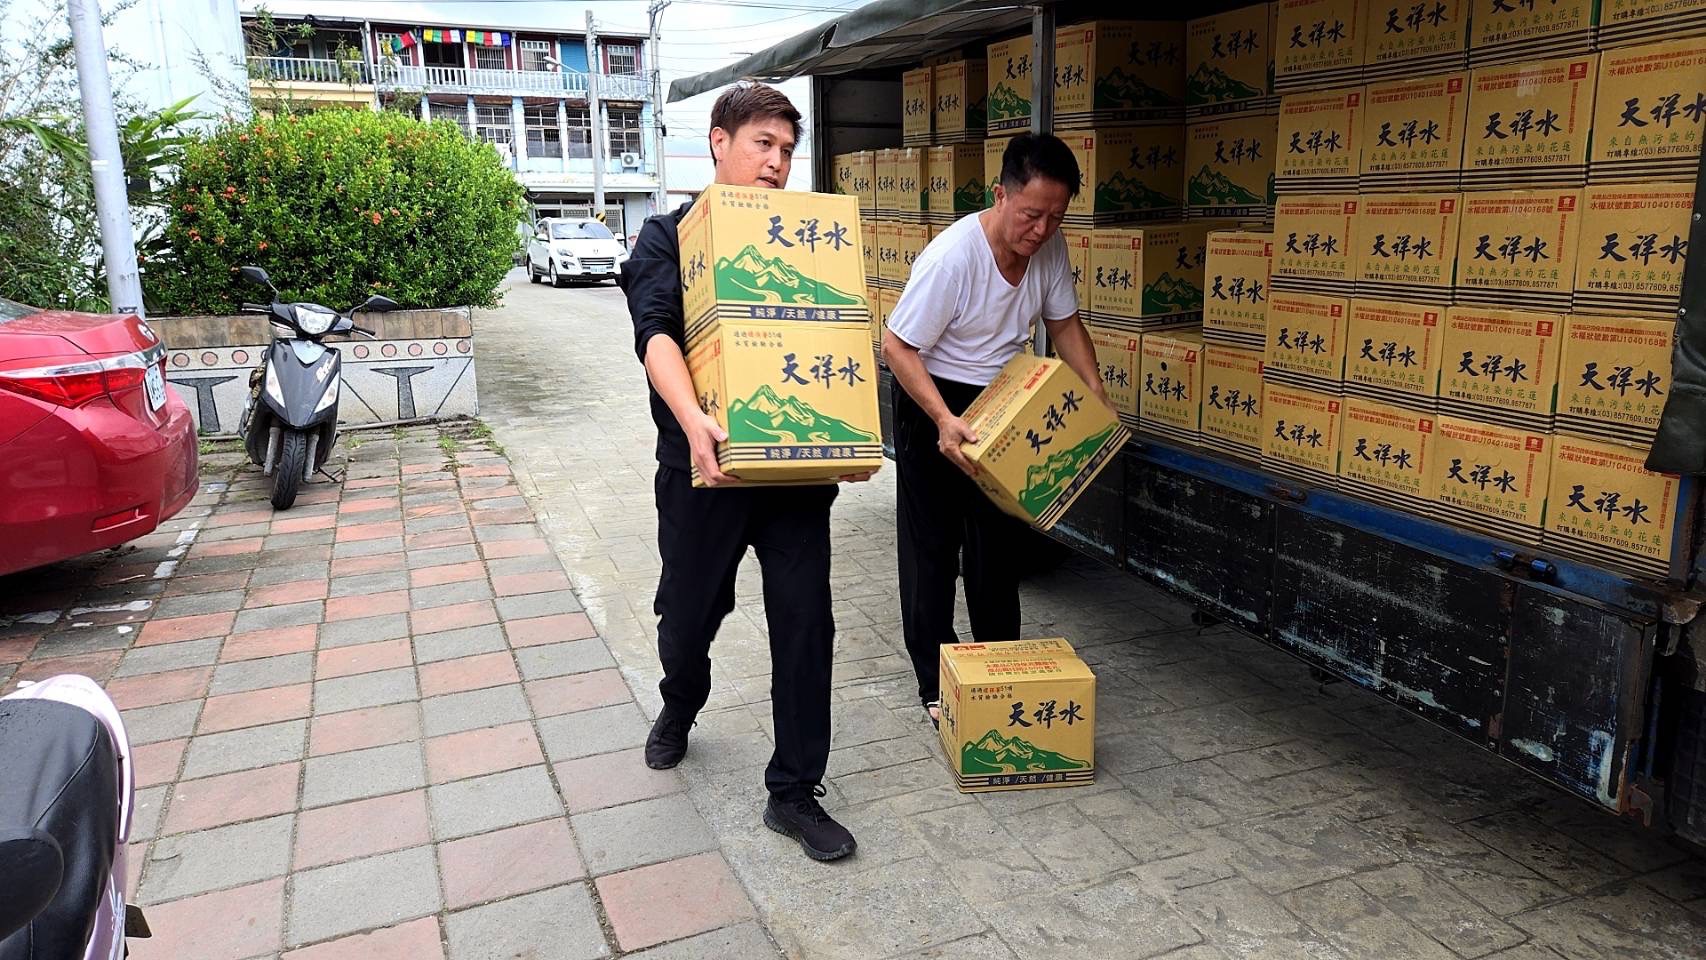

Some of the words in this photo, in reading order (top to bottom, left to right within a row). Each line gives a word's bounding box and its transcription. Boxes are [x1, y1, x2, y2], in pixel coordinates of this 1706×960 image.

[1385, 1, 1448, 34] 天祥水
[1211, 28, 1259, 59] 天祥水
[1289, 20, 1346, 48] 天祥水
[1006, 54, 1032, 80] 天祥
[1376, 119, 1440, 148] 天祥水
[1483, 109, 1562, 141] 天祥水
[1214, 138, 1262, 165] 天祥水
[1288, 129, 1343, 156] 天祥水
[766, 215, 854, 252] 天祥水
[1284, 232, 1339, 258] 天祥水
[1371, 233, 1434, 261] 天祥水
[1473, 234, 1550, 265] 天祥水
[1598, 233, 1689, 266] 天祥水
[1096, 266, 1133, 292] 天祥水
[1211, 276, 1264, 304] 天祥水
[1278, 328, 1326, 354] 天祥水
[1360, 339, 1417, 368] 天祥水
[781, 352, 866, 389] 天祥水
[1457, 351, 1528, 383] 天祥水
[1578, 362, 1664, 397] 天祥水
[1145, 373, 1188, 402] 天祥水
[1208, 385, 1258, 417] 天祥水
[1025, 389, 1084, 456] 天祥水
[1275, 420, 1323, 448] 天祥水
[1354, 439, 1412, 470] 天祥水
[1448, 459, 1518, 494] 天祥水
[1566, 485, 1651, 524] 天祥水
[1008, 700, 1086, 729] 天祥水
